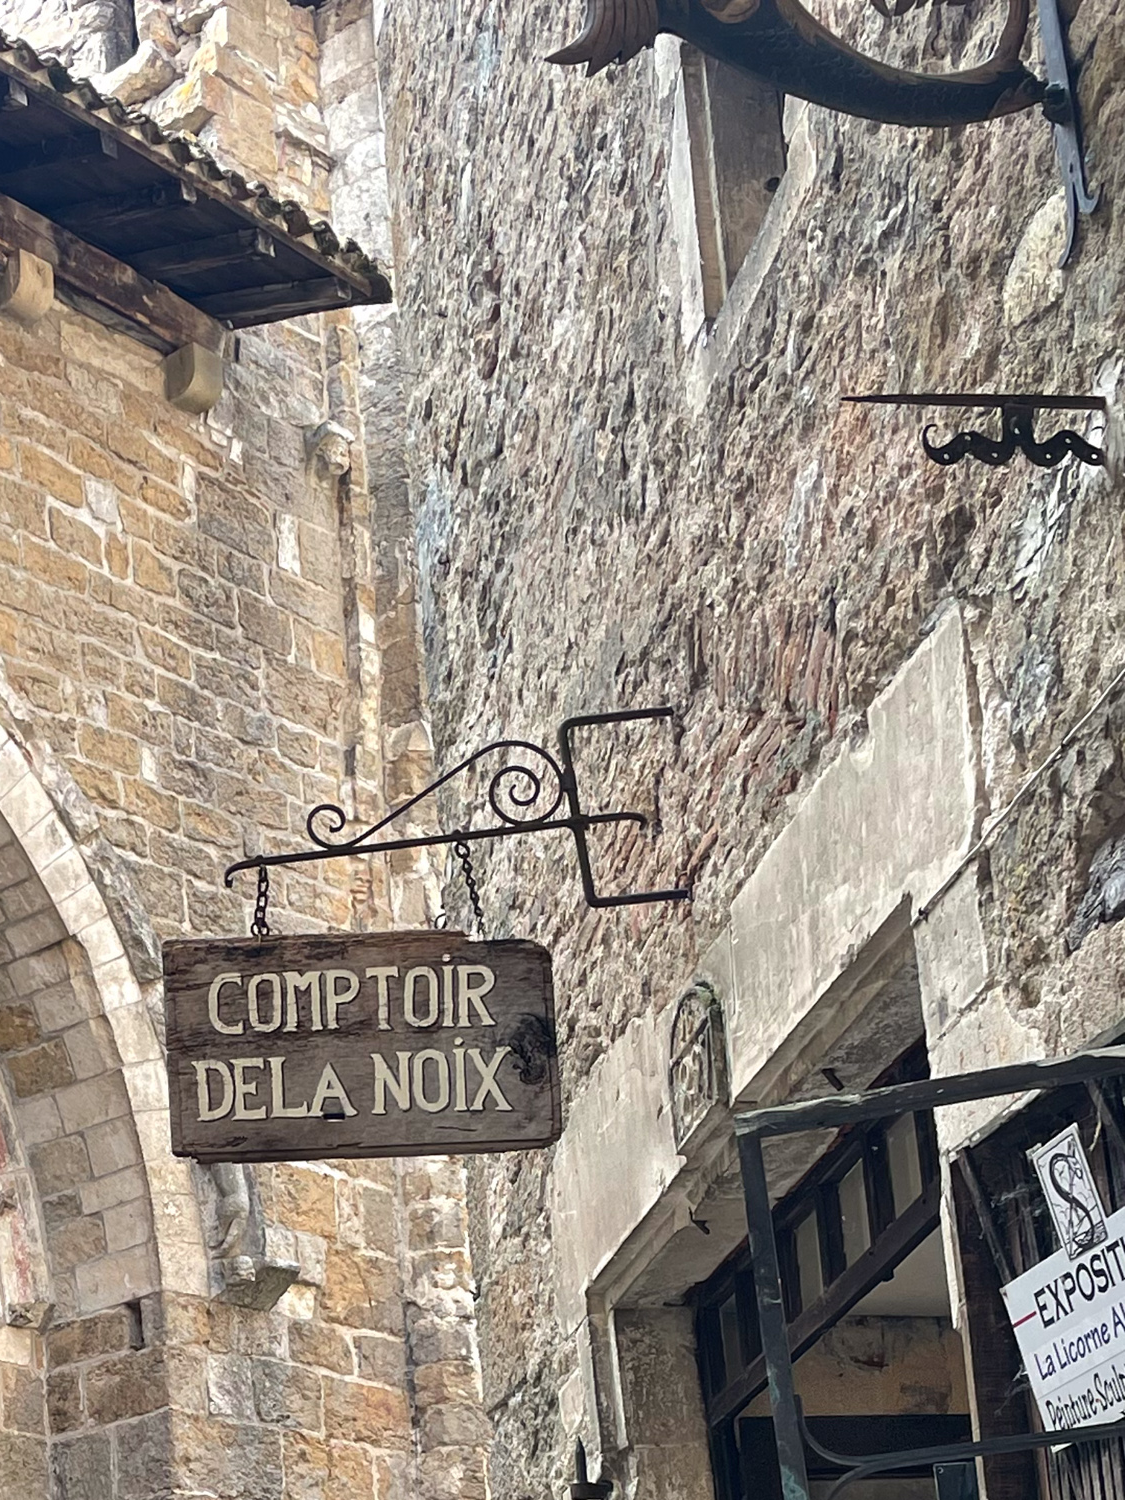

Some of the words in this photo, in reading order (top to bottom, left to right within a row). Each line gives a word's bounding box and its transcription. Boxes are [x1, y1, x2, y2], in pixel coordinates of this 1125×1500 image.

[208, 953, 497, 1036] COMPTOIR
[370, 1036, 514, 1117] NOIX
[1033, 1236, 1125, 1329] EXPOSIT
[1033, 1352, 1057, 1381] La
[1052, 1322, 1111, 1370] Licorne
